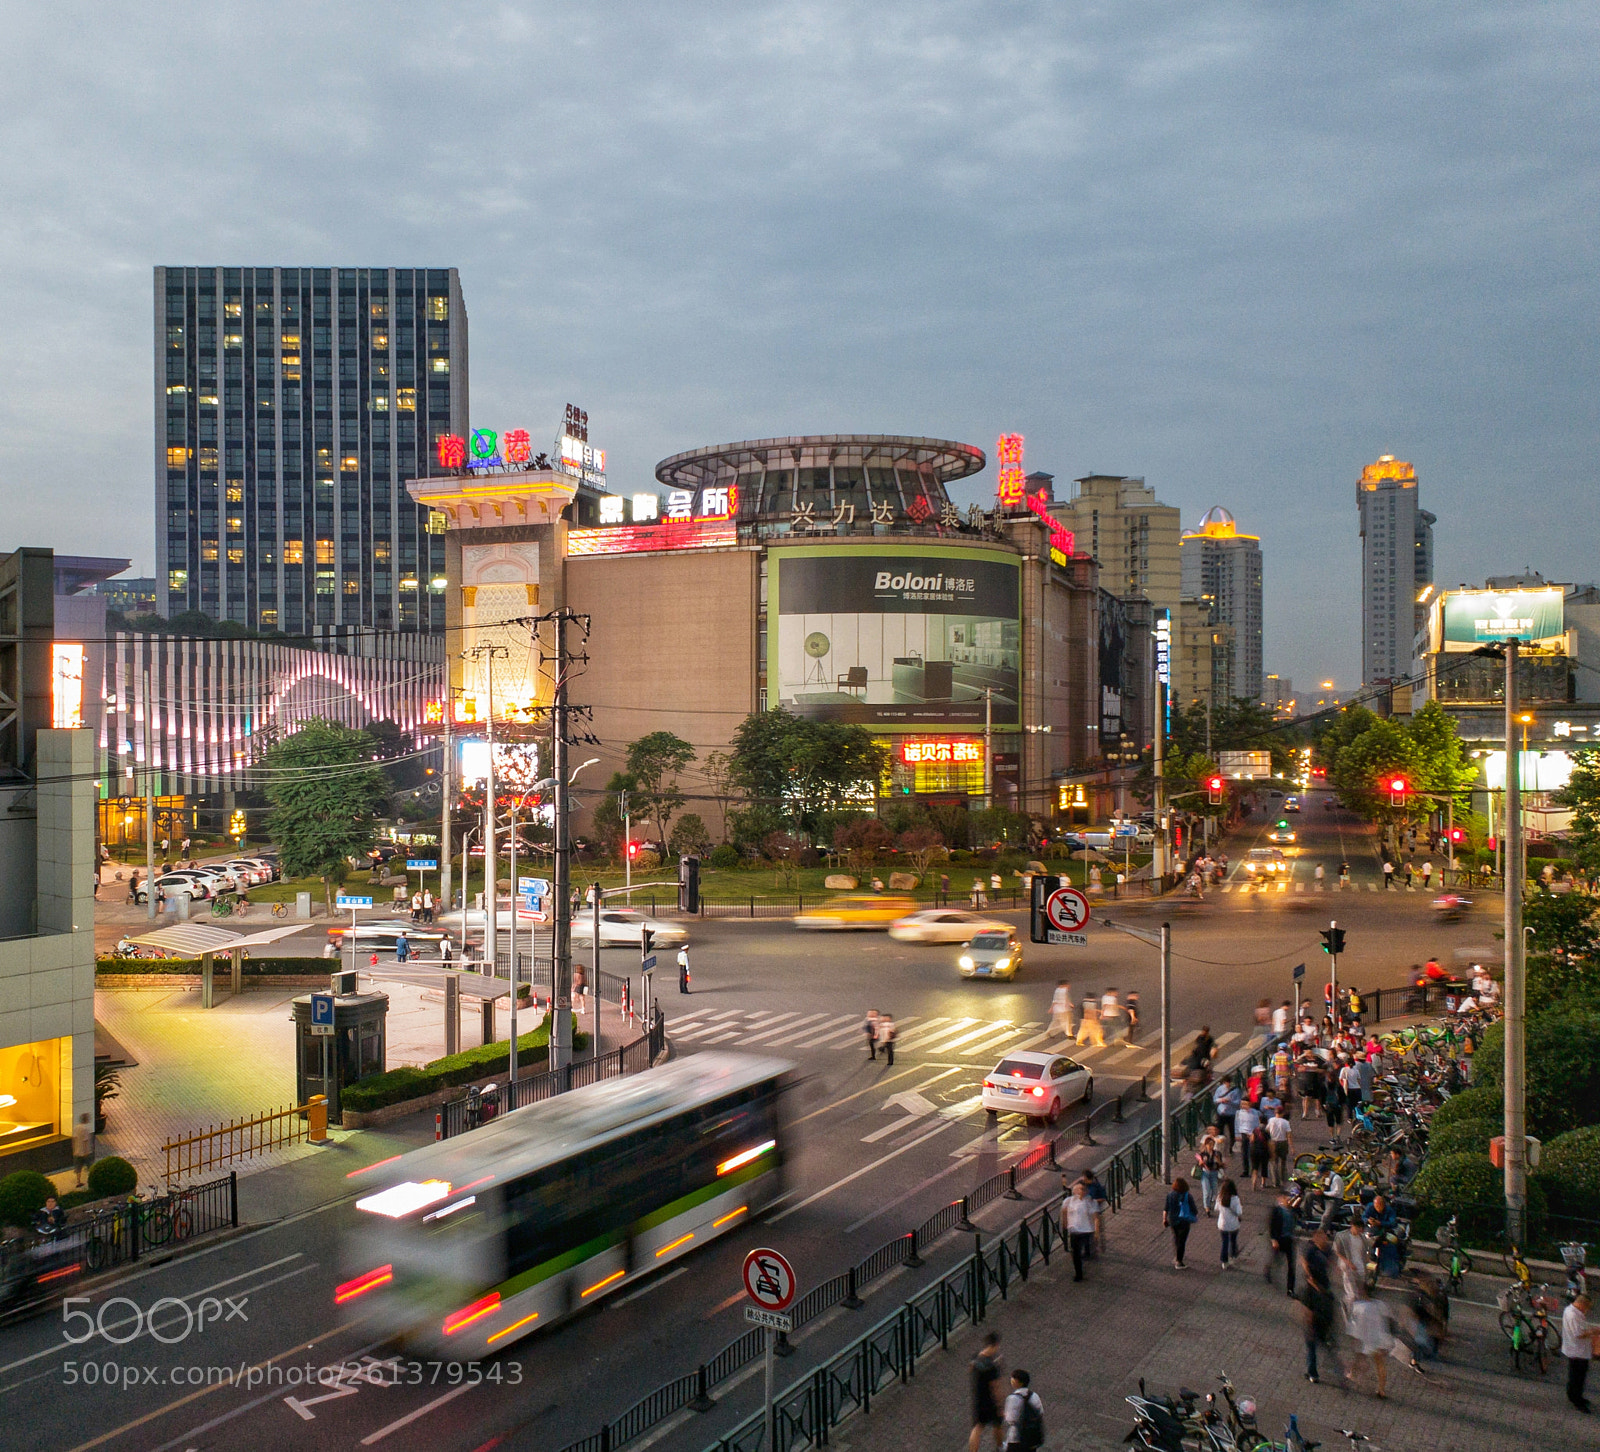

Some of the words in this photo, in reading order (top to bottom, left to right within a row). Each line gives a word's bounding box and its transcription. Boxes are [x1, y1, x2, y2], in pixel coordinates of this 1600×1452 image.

[728, 486, 738, 514] KTV
[874, 571, 943, 590] Boloni
[945, 577, 975, 592] 博洛尼
[316, 1000, 328, 1020] P
[747, 1307, 791, 1331] 除公共汽车外
